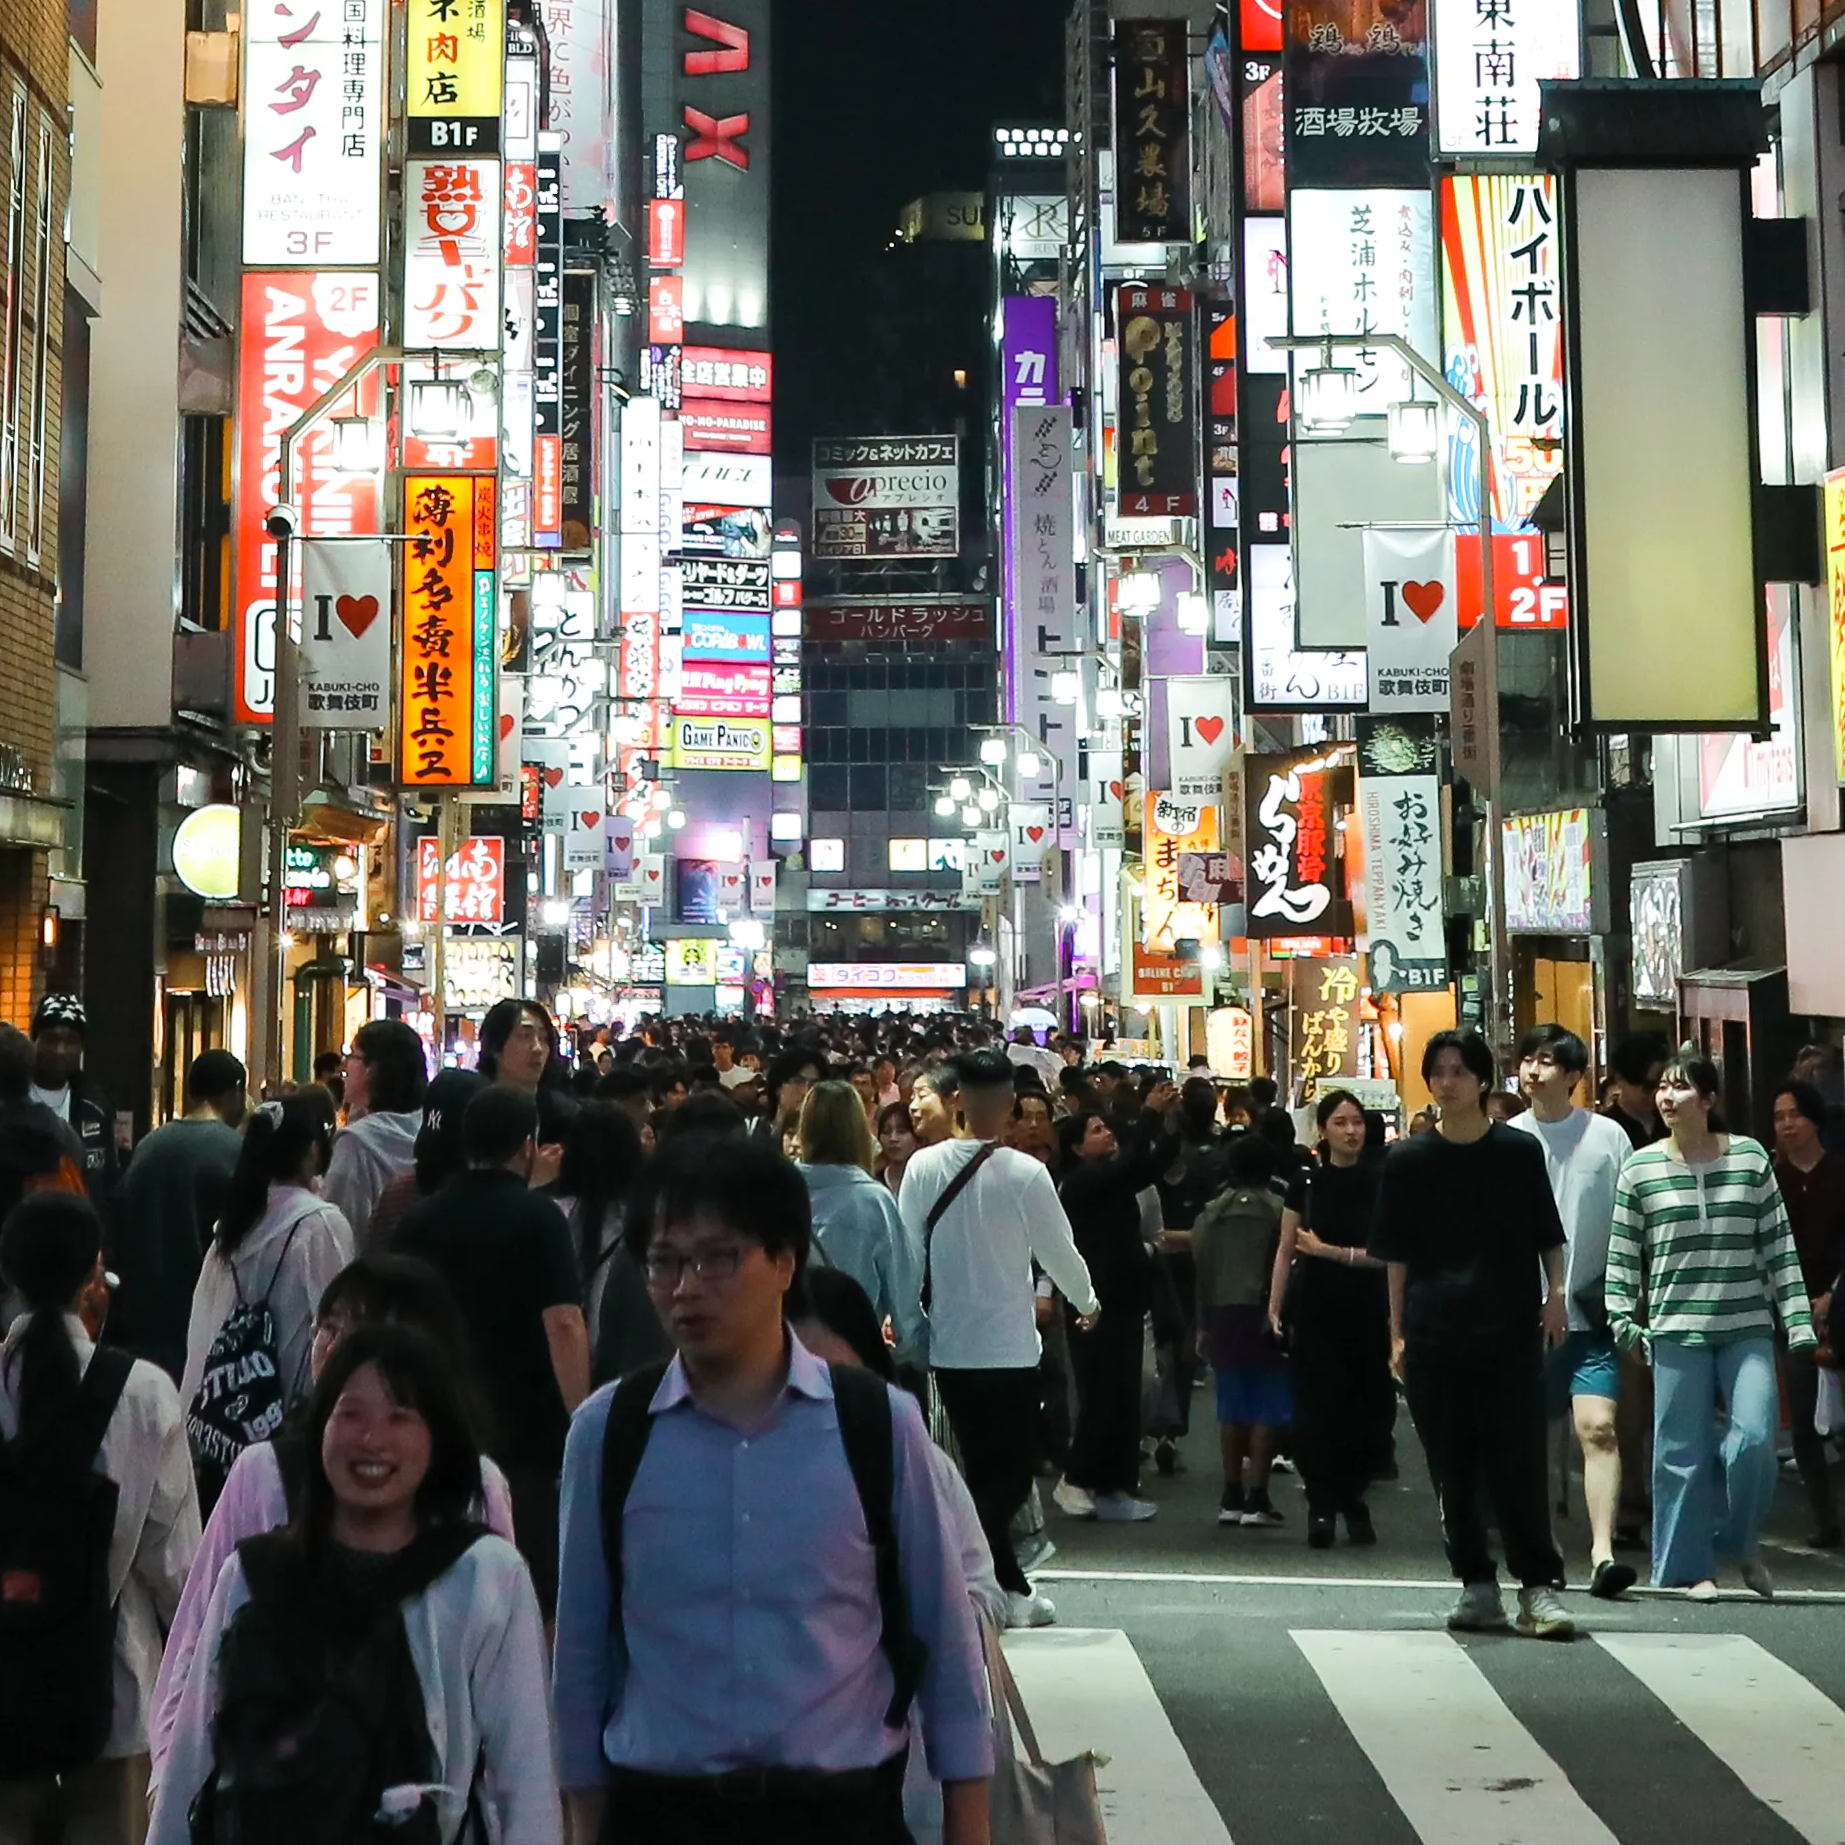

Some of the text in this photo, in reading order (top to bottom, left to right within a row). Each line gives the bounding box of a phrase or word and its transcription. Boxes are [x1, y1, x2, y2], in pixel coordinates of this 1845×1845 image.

[1244, 61, 1271, 82] 3F
[430, 121, 478, 147] B1F
[1294, 106, 1423, 139] 酒場牧場
[286, 231, 334, 255] 3F
[413, 164, 491, 341] 熟女キャバク
[330, 286, 369, 311] 2F
[1131, 291, 1177, 309] 麻雀
[1349, 203, 1379, 393] 芝浦ホルモン
[1506, 182, 1558, 427] ハイボール
[1107, 530, 1171, 544] MEAT GARDEN
[1380, 580, 1400, 627] I
[313, 595, 333, 641] I
[860, 623, 935, 638] ハンバーグ
[1376, 667, 1450, 678] KABUKI-CHO
[307, 682, 381, 692] KABUKI-CHO
[1377, 679, 1450, 697] 歌舞伎町
[307, 694, 380, 712] 歌舞伎町
[1179, 716, 1194, 747] I
[1366, 791, 1388, 932] HIROSHIMA TEPPANYAKI
[1389, 789, 1439, 942] お好み焼き
[1406, 967, 1446, 987] B1F
